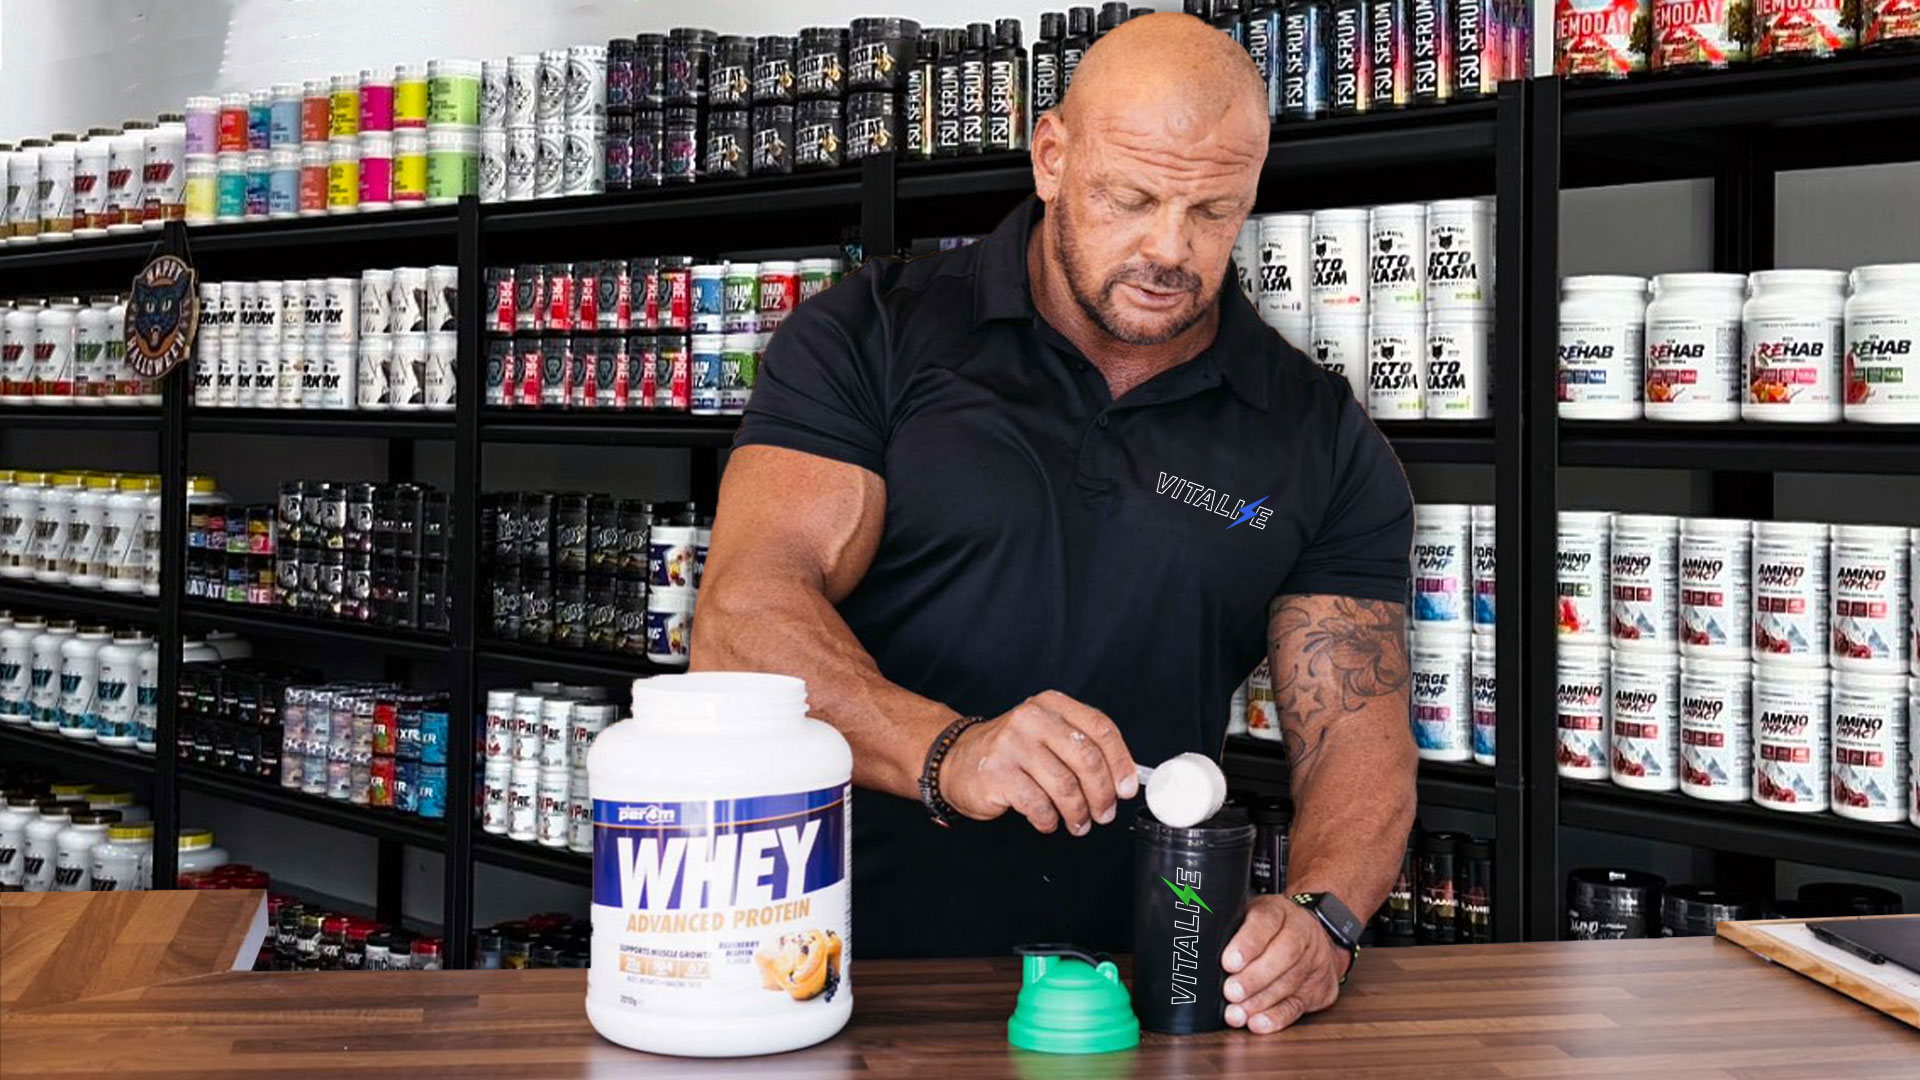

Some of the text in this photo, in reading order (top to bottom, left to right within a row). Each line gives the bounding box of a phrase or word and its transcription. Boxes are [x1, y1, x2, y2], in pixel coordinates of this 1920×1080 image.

[1655, 1, 1719, 28] EMODAY
[1375, 2, 1392, 99] FSU SERUM
[1460, 0, 1479, 88] FSU SERU
[1287, 14, 1304, 107] FSU SERUM
[1338, 9, 1356, 105] FSU SERUM
[1038, 53, 1056, 108] SERUM
[1416, 60, 1436, 93] FSU
[942, 66, 959, 146] FSU SERUM
[964, 61, 983, 142] FSU SERUM
[992, 61, 1010, 143] FSU SERUM
[1314, 259, 1343, 272] CTO
[1430, 251, 1471, 266] ECTO
[147, 260, 183, 285] HAPPY
[1260, 265, 1287, 279] CTO
[1312, 270, 1347, 286] ASM
[1428, 264, 1477, 280] PLASM
[1260, 277, 1292, 292] ASM
[127, 332, 186, 375] HALLOWEEN
[1558, 345, 1614, 360] REHAB
[1650, 344, 1705, 360] REHAB
[1758, 342, 1824, 358] REHAB
[1851, 340, 1912, 357] REHAB
[1372, 362, 1413, 375] ECTO
[1428, 362, 1460, 375] CTO
[1427, 374, 1466, 389] LASM
[1414, 545, 1455, 557] FORGE
[1474, 546, 1496, 558] FOR
[1557, 552, 1591, 563] MINO
[1557, 562, 1586, 572] PACT
[1682, 558, 1723, 571] AMINO
[1758, 564, 1804, 577] AMINO
[1838, 567, 1886, 581] AMINO
[1412, 672, 1450, 685] FORGE
[1558, 684, 1602, 697] AMINO
[1615, 690, 1657, 704] AMINO
[1683, 697, 1723, 711] AMINO
[1761, 711, 1808, 726] AMINO
[1837, 715, 1883, 730] AMINO
[617, 819, 822, 910] WHEY
[626, 898, 811, 933] ADVANCED PROTEIN
[620, 944, 712, 959] SUPPORTS MUSCLE GROWT
